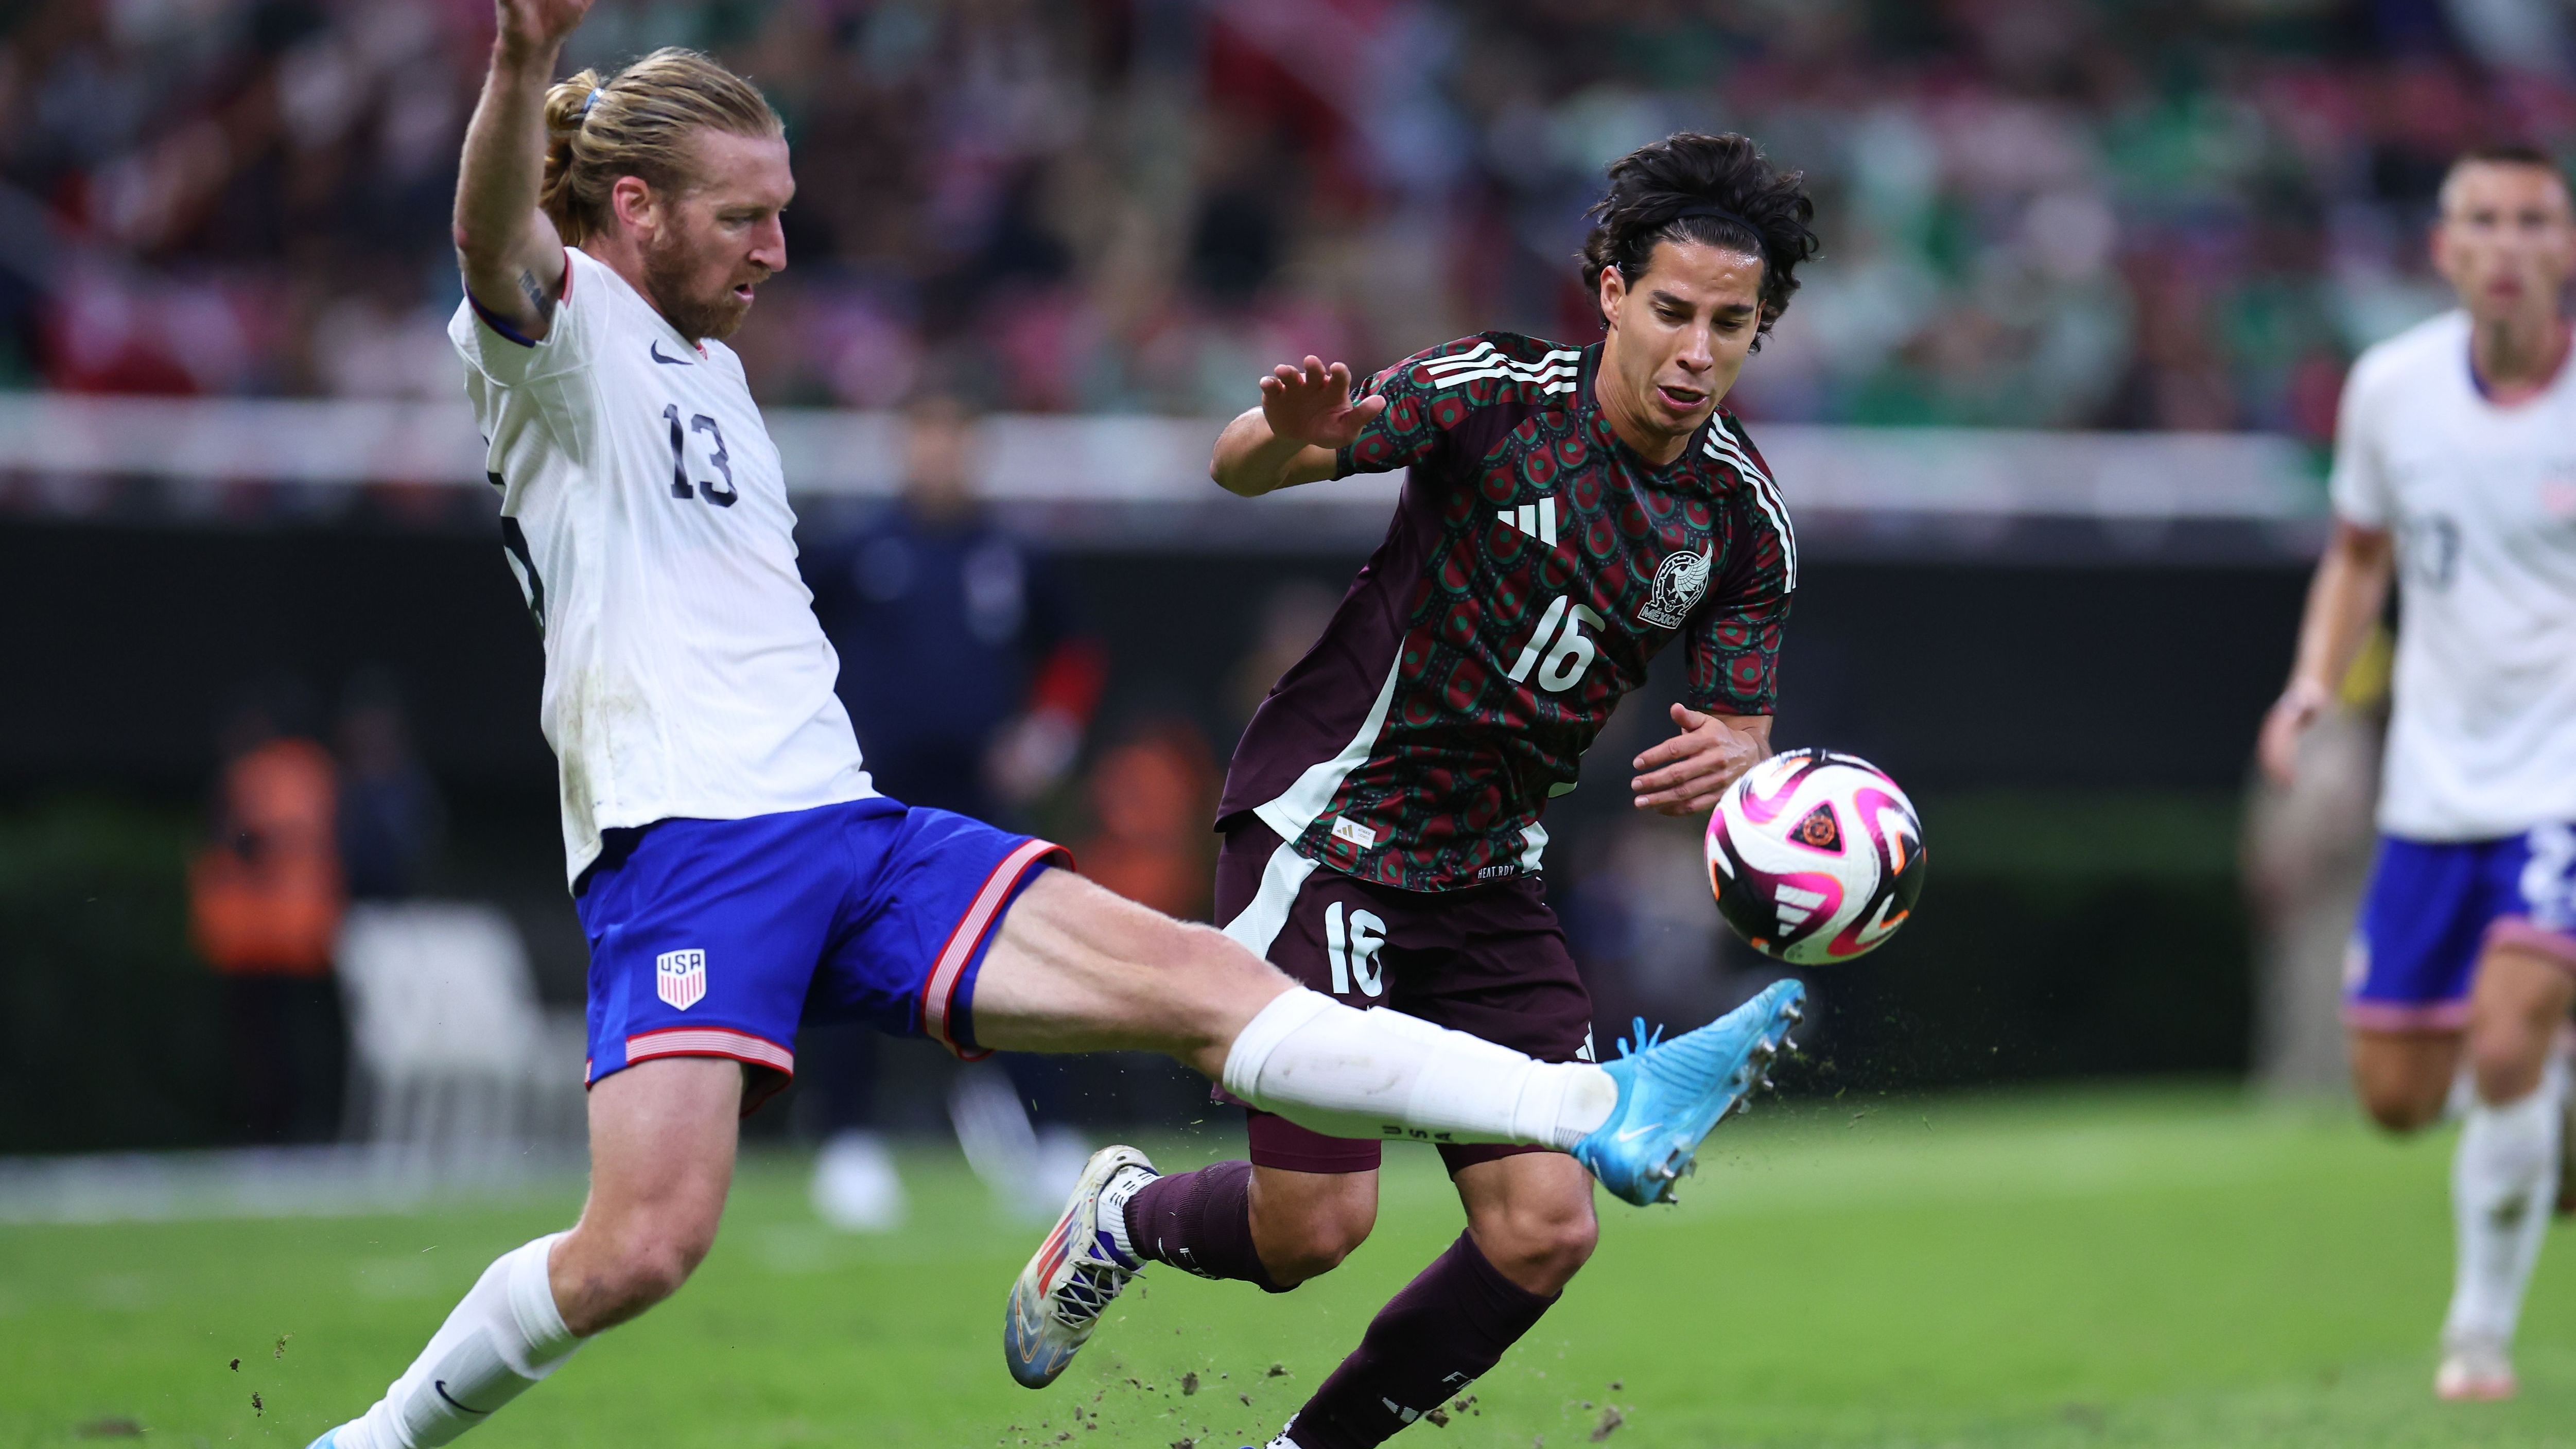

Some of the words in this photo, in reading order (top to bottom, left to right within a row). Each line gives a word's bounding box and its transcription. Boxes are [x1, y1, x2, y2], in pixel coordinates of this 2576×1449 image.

[663, 403, 739, 509] 13
[1641, 606, 1681, 626] MÉXICO
[1507, 595, 1605, 692] 16
[1477, 865, 1515, 879] HEAT.RDY
[1325, 901, 1387, 998] 16
[661, 953, 701, 975] USA
[1382, 1125, 1451, 1141] USA
